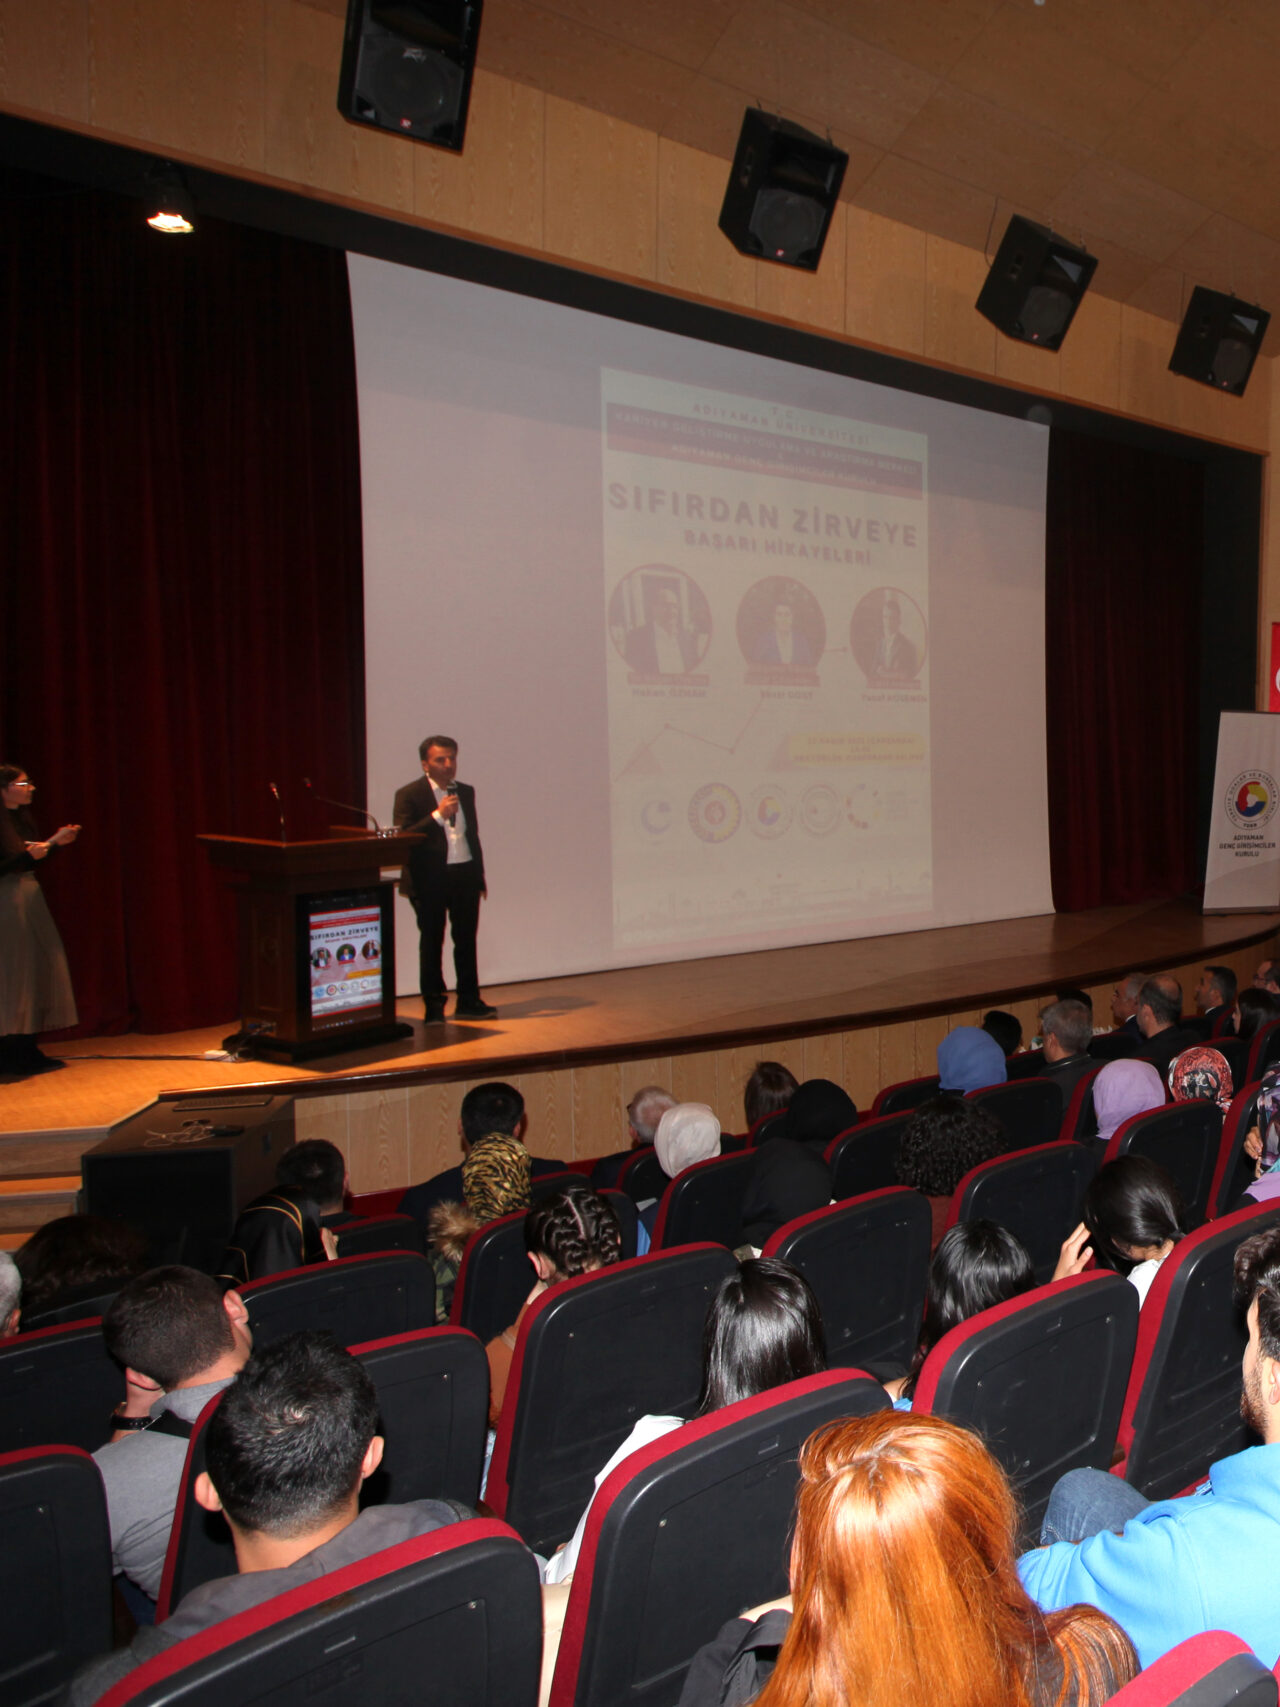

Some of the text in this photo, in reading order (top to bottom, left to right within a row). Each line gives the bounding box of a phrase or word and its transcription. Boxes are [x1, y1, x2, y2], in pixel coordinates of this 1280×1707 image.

[693, 403, 768, 426] ADIYAMAN
[608, 482, 918, 548] SIFIRDAN ZİRVEYE
[684, 529, 872, 566] BAŞARI HİKAYELERİ
